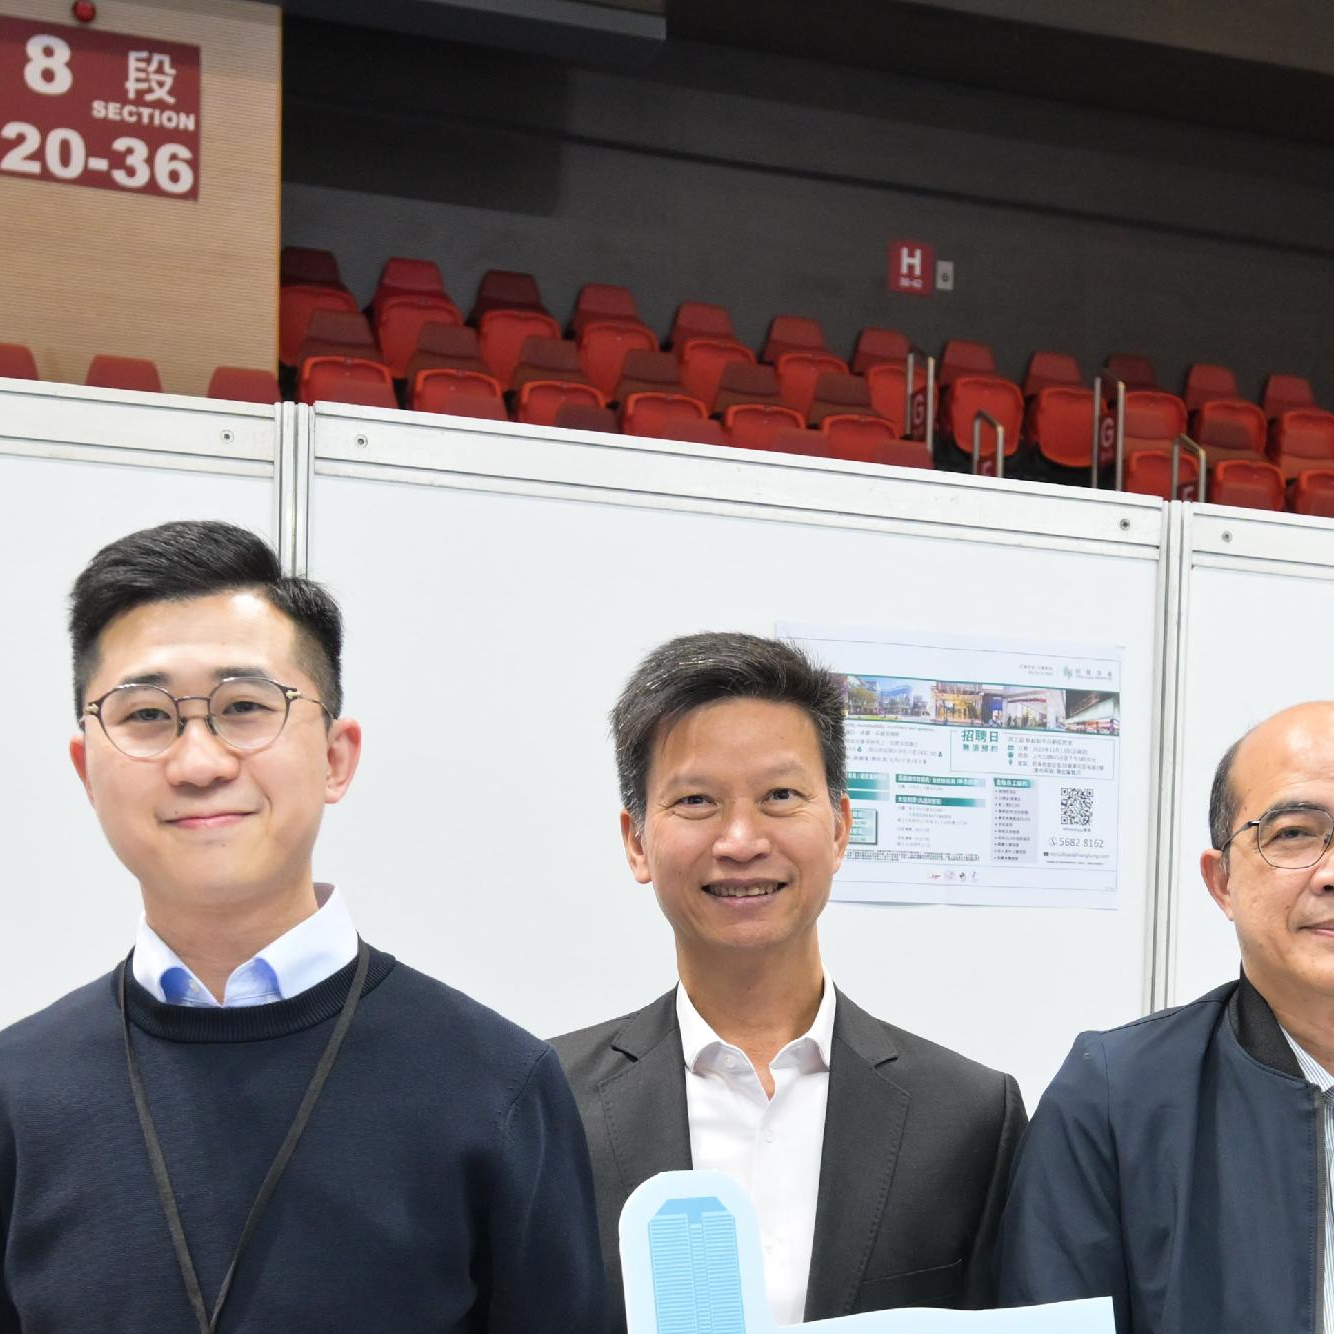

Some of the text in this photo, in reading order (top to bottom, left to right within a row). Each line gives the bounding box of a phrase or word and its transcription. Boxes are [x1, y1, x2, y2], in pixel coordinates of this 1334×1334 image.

[23, 33, 177, 104] 8 段
[91, 100, 195, 131] SECTION
[0, 120, 194, 194] 20-36
[900, 247, 922, 275] H
[1100, 417, 1115, 449] G
[961, 729, 999, 743] 招聘日
